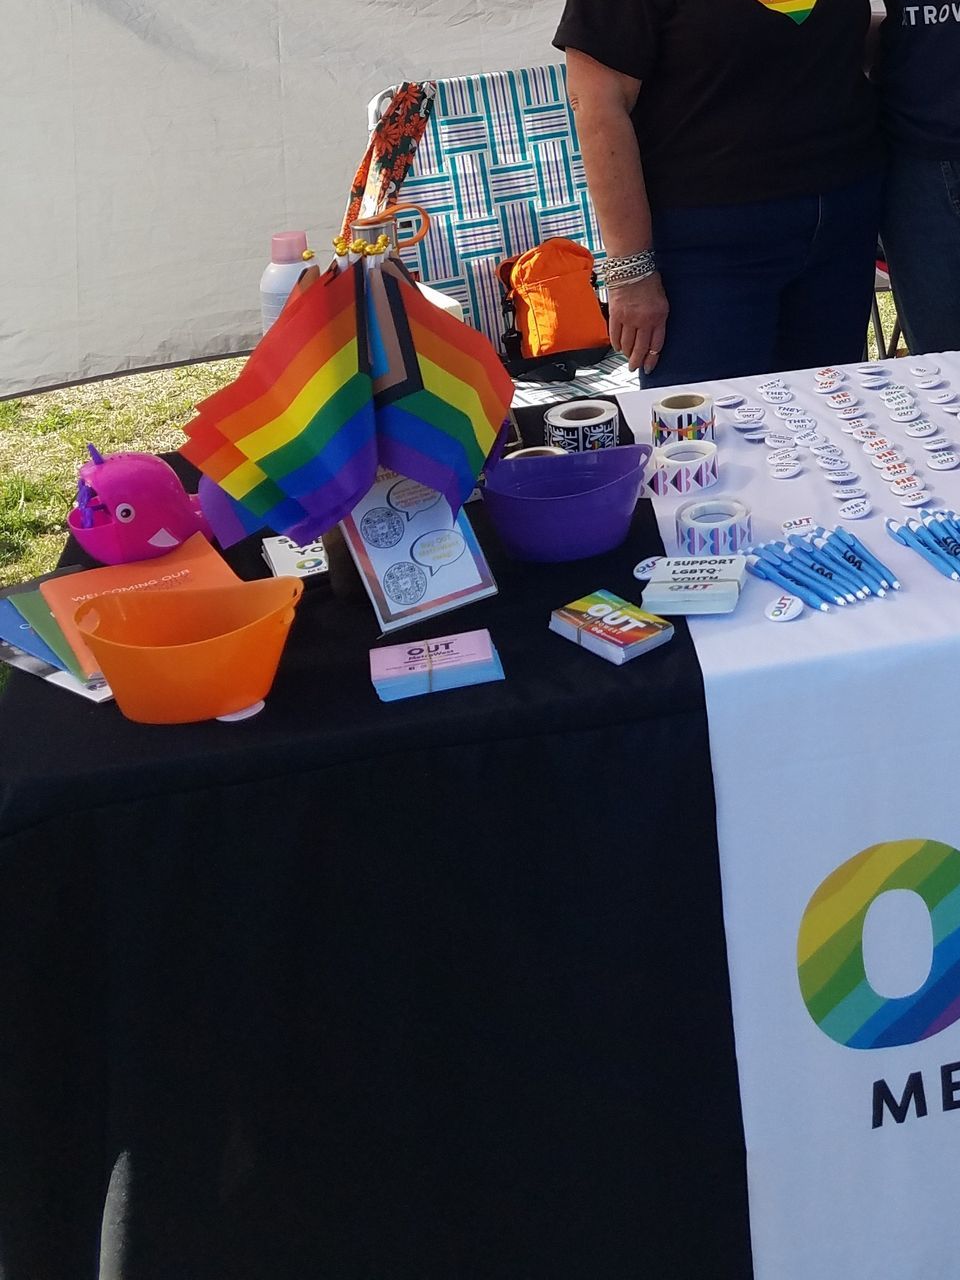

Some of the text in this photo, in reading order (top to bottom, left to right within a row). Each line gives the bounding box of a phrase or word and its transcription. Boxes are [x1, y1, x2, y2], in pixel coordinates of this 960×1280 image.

[782, 517, 812, 528] OUT
[673, 558, 736, 567] SUPPORT
[72, 568, 190, 602] WELCOMING OUR
[771, 596, 792, 617] OUT
[587, 604, 647, 632] OUT
[407, 641, 454, 656] OUT
